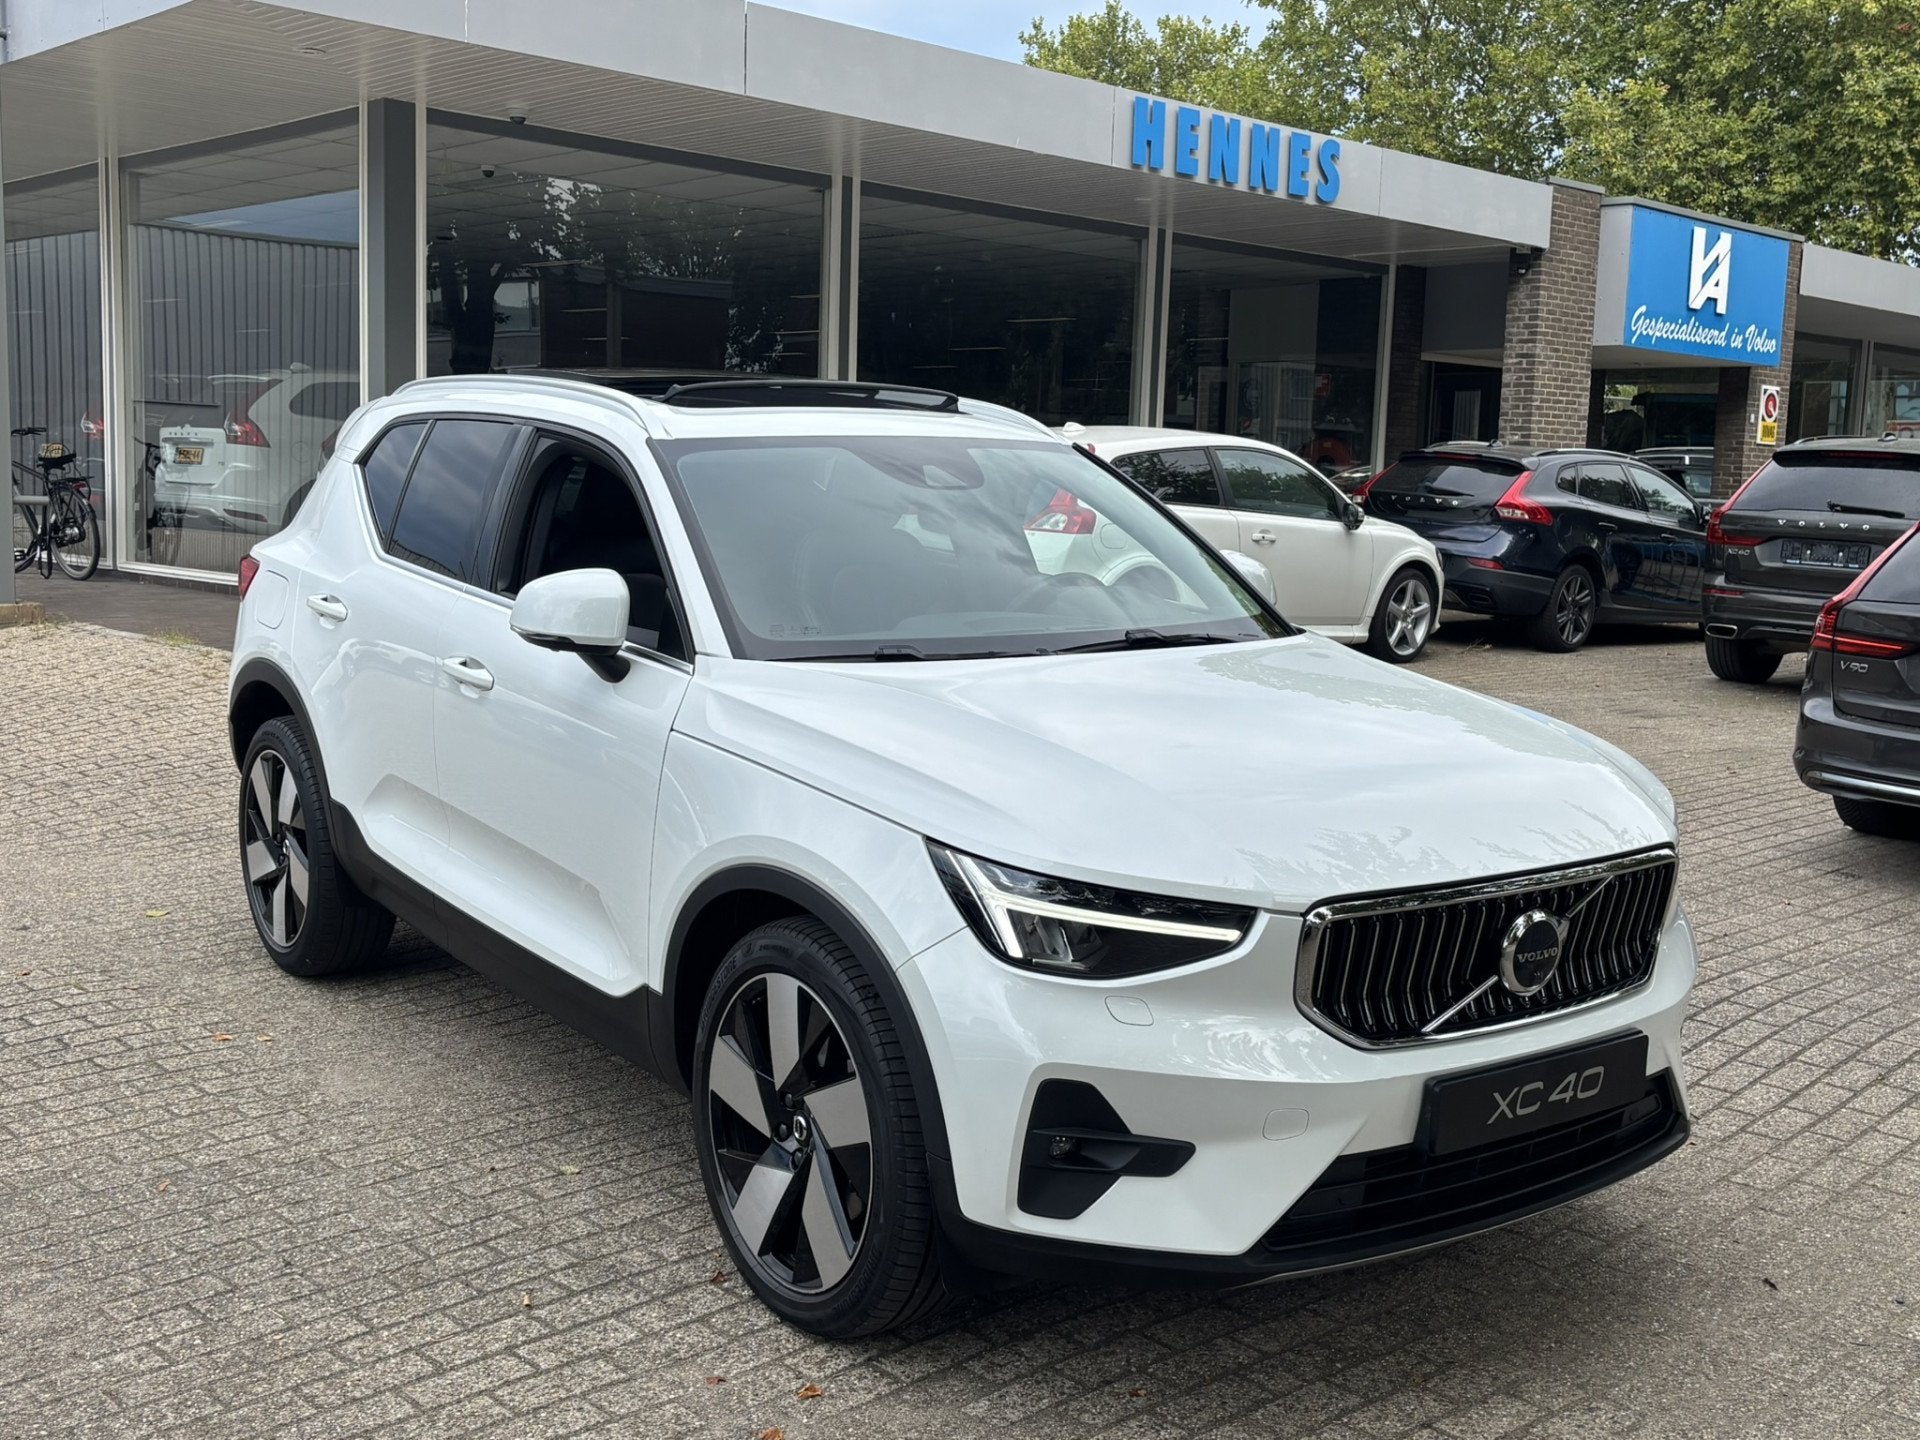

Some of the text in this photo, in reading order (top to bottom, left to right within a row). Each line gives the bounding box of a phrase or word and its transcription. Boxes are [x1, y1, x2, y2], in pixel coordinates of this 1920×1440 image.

[1132, 96, 1341, 203] HENNES
[1631, 304, 1777, 354] Gespecialiseerd in Volvo
[1391, 495, 1459, 506] VOLVO
[1778, 518, 1870, 531] VOLVO
[1840, 660, 1869, 673] V90
[1517, 946, 1558, 963] VOLVO
